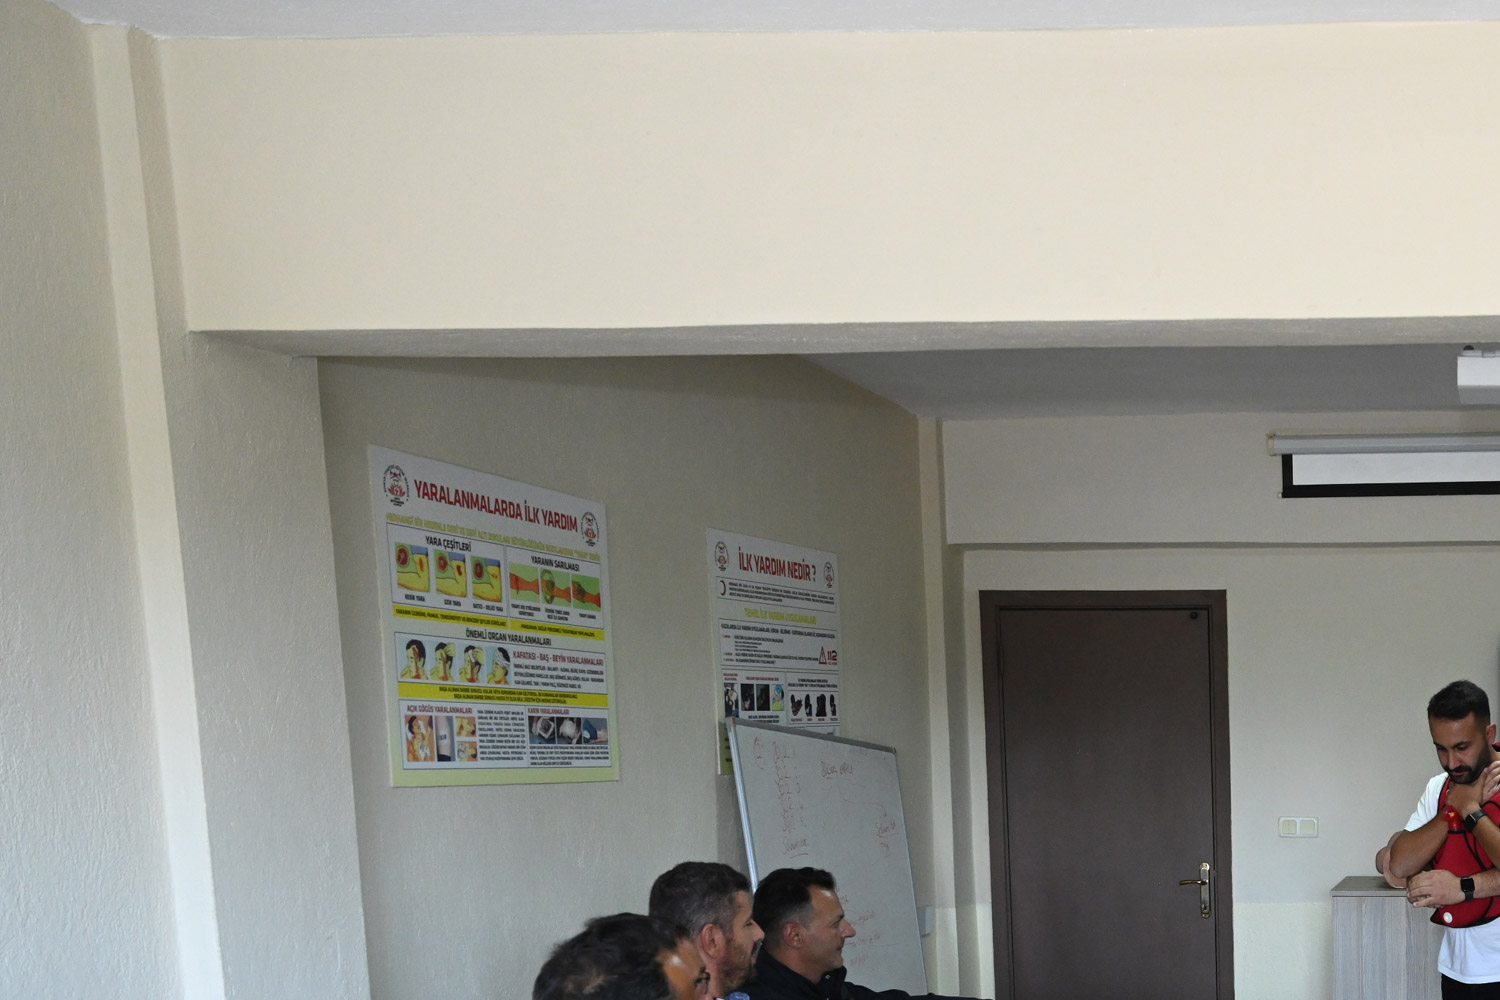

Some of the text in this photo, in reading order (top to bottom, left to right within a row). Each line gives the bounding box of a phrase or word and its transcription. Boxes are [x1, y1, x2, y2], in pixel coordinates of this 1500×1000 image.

[414, 479, 523, 521] YARALANMALARDA
[524, 500, 540, 524] İLK
[541, 509, 578, 533] YARDIM
[425, 535, 472, 552] YARA ÇEŞİTLERİ
[531, 555, 580, 572] YARANIN SARILMASI
[738, 546, 817, 582] İLK YARDIM NEDİR ?
[465, 627, 552, 646] ÖNEMLİ ORGAN YARALANMALARI
[827, 650, 838, 661] 112
